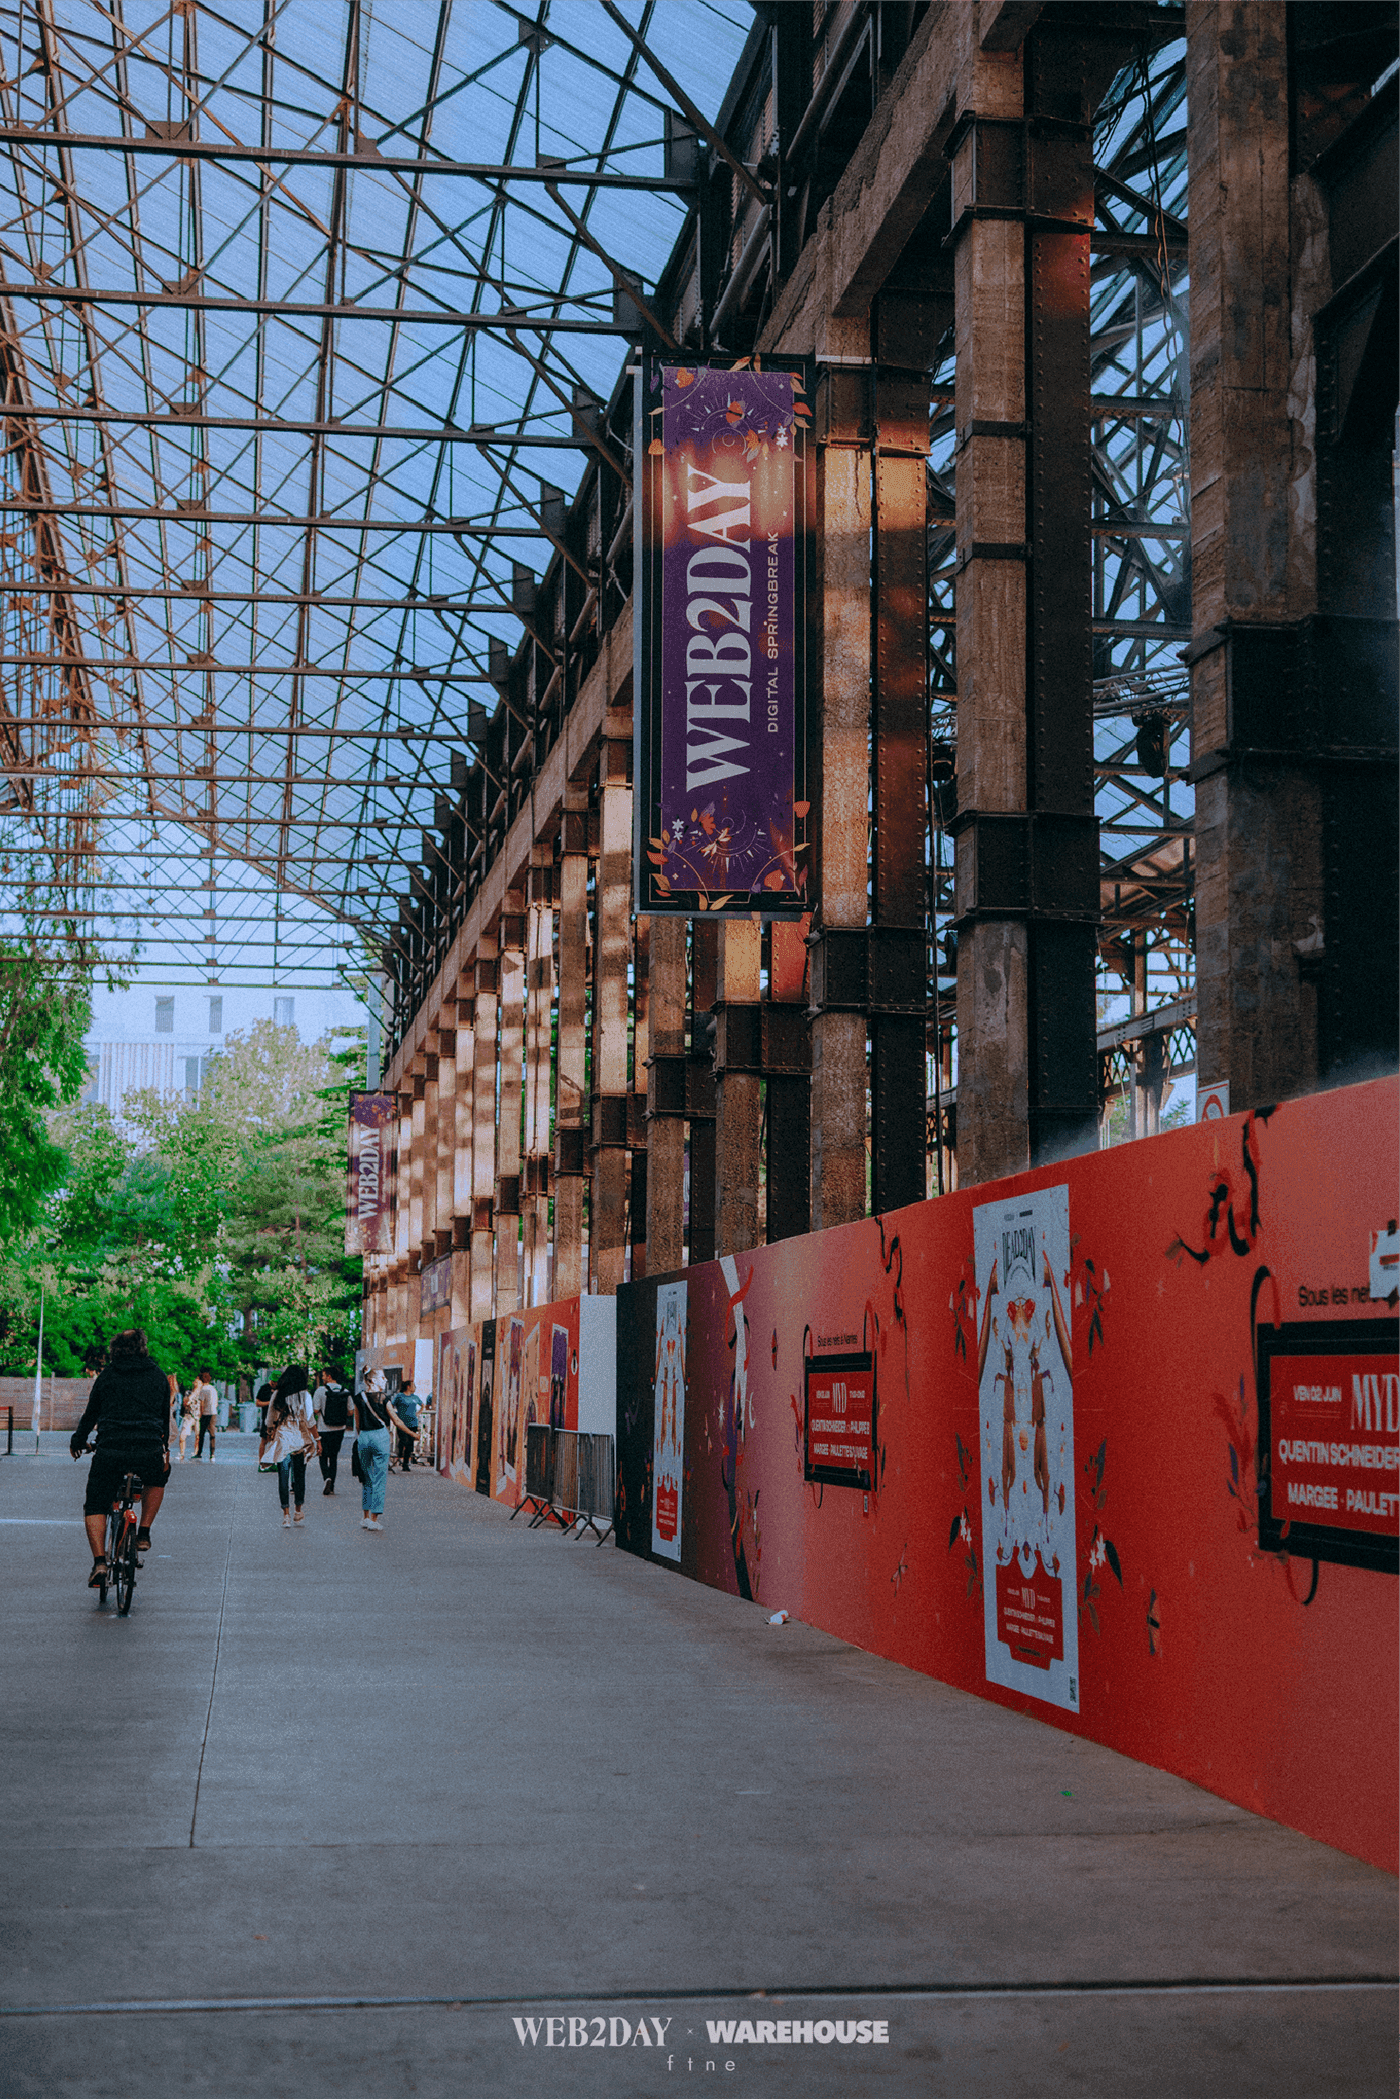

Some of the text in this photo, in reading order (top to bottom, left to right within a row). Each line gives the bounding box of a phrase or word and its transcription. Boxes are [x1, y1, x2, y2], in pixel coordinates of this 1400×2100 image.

[684, 463, 753, 793] WEB2DAY
[768, 531, 779, 733] DIGITAL SPRINGBREAK
[358, 1123, 380, 1220] WEB2DAY
[1299, 1285, 1329, 1307] Sous
[1332, 1284, 1349, 1305] les
[1350, 1374, 1400, 1432] MYD
[1278, 1439, 1329, 1465] QUENTIN
[1288, 1482, 1338, 1510] MARGEE
